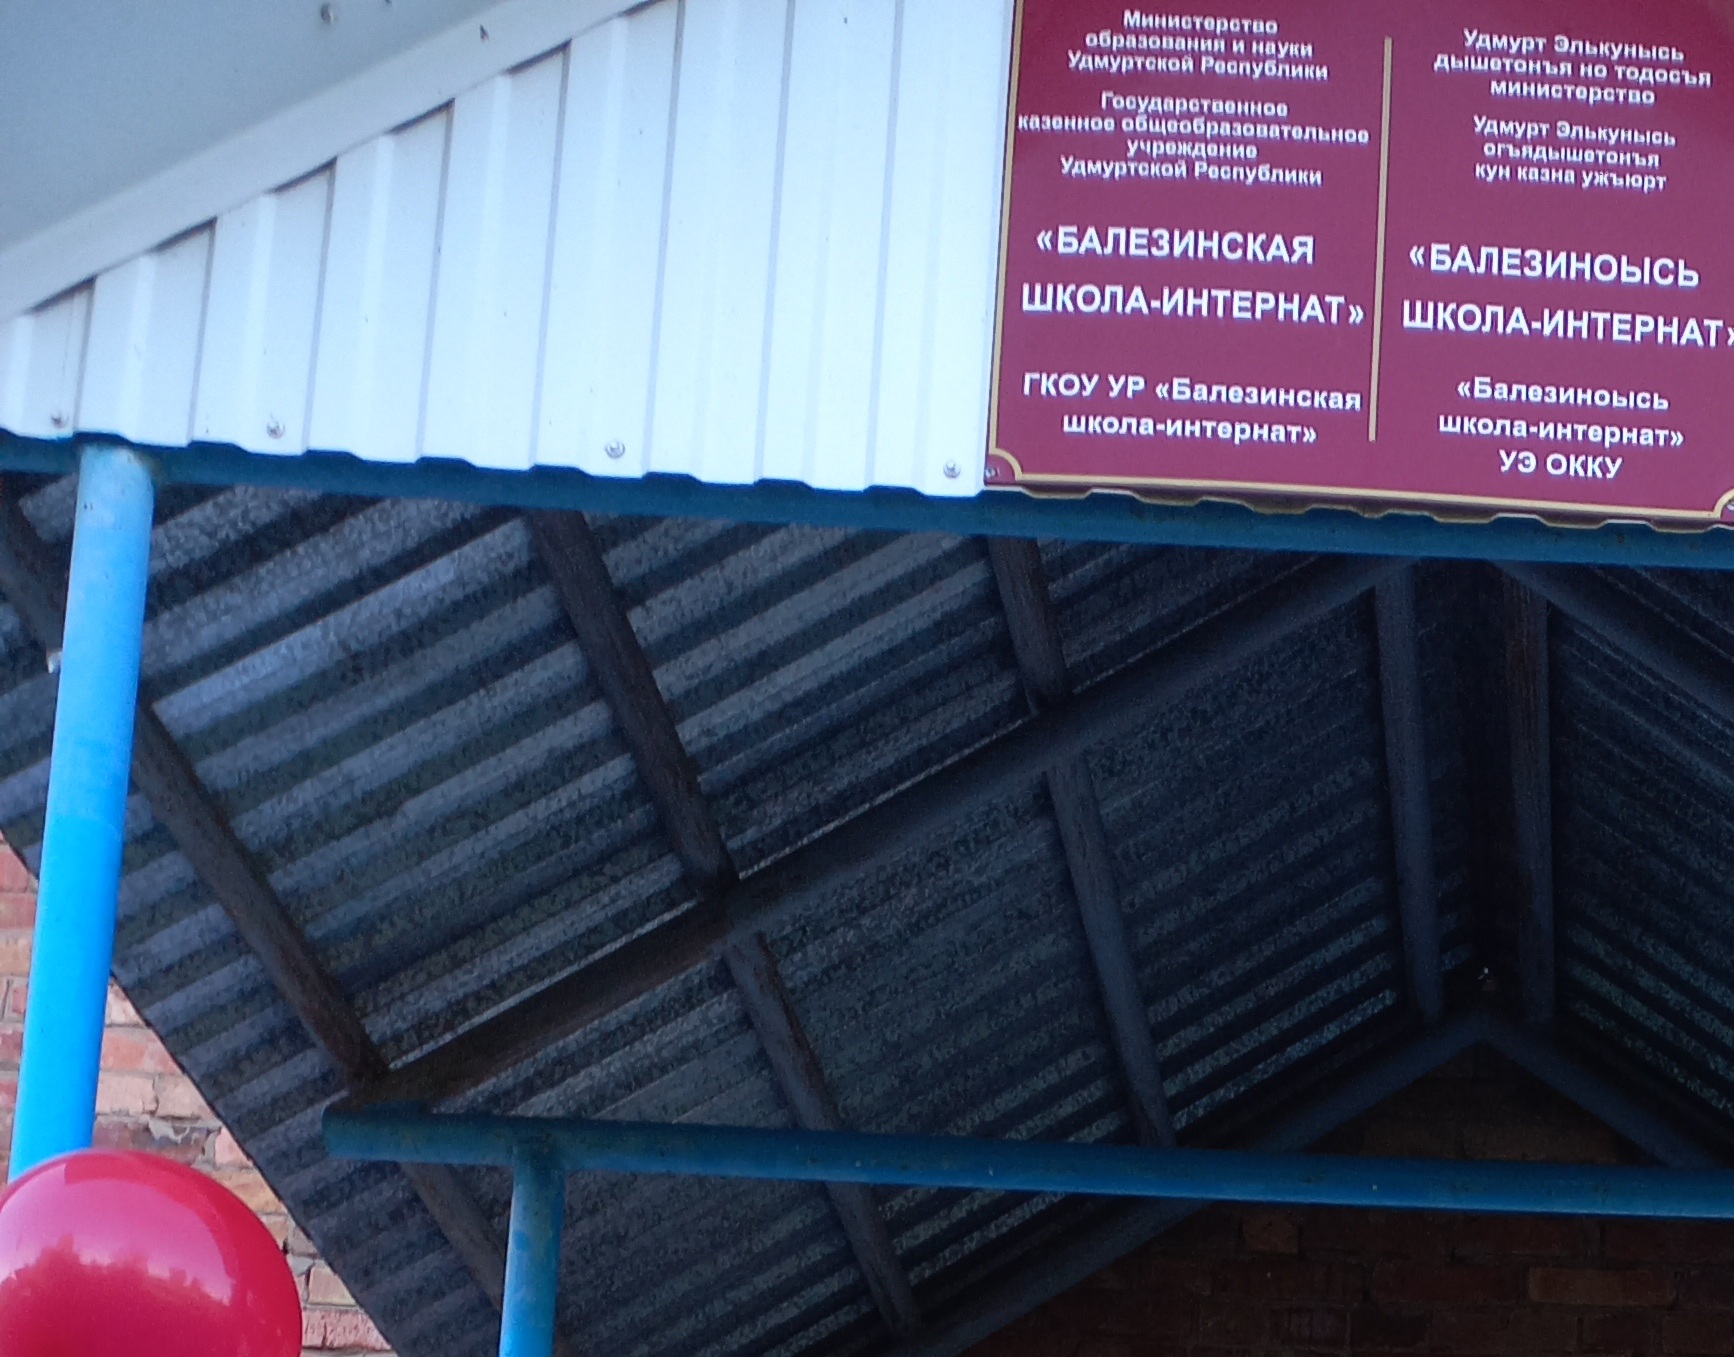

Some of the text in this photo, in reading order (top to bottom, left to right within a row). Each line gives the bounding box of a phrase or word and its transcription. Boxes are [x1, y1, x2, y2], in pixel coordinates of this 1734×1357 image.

[1124, 10, 1278, 35] Министерство
[1085, 29, 1313, 59] образования и науки
[1463, 28, 1685, 63] Удмурт Элькунысь
[1068, 50, 1328, 80] Удмуртской Республики
[1433, 53, 1712, 87] дышетонъя но тодосъя
[1101, 90, 1289, 118] Государственное
[1490, 78, 1656, 105] министерство
[1017, 114, 1370, 144] казенное общеобразовательное
[1473, 115, 1676, 147] Удмурт Элькунысь
[1126, 139, 1258, 159] учреждение
[1483, 142, 1660, 168] огъядышетонъя
[1061, 155, 1323, 187] Удмуртской Республики
[1475, 163, 1667, 193] кун казна ужъюрт
[1036, 225, 1314, 264] «БАЛЕЗИНСКАЯ
[1410, 243, 1700, 288] «БАЛЕЗИНОЫСЬ
[1022, 282, 1364, 325] ШКОЛА-ИНТЕРНАТ»
[1023, 372, 1362, 411] ГКОУ УР «Балезинская
[1457, 376, 1670, 411] «Балезиноысь
[1062, 414, 1318, 444] школа-интернат»
[1439, 415, 1684, 448] школа-интернат»
[1499, 450, 1623, 479] УЭ ОККУ
